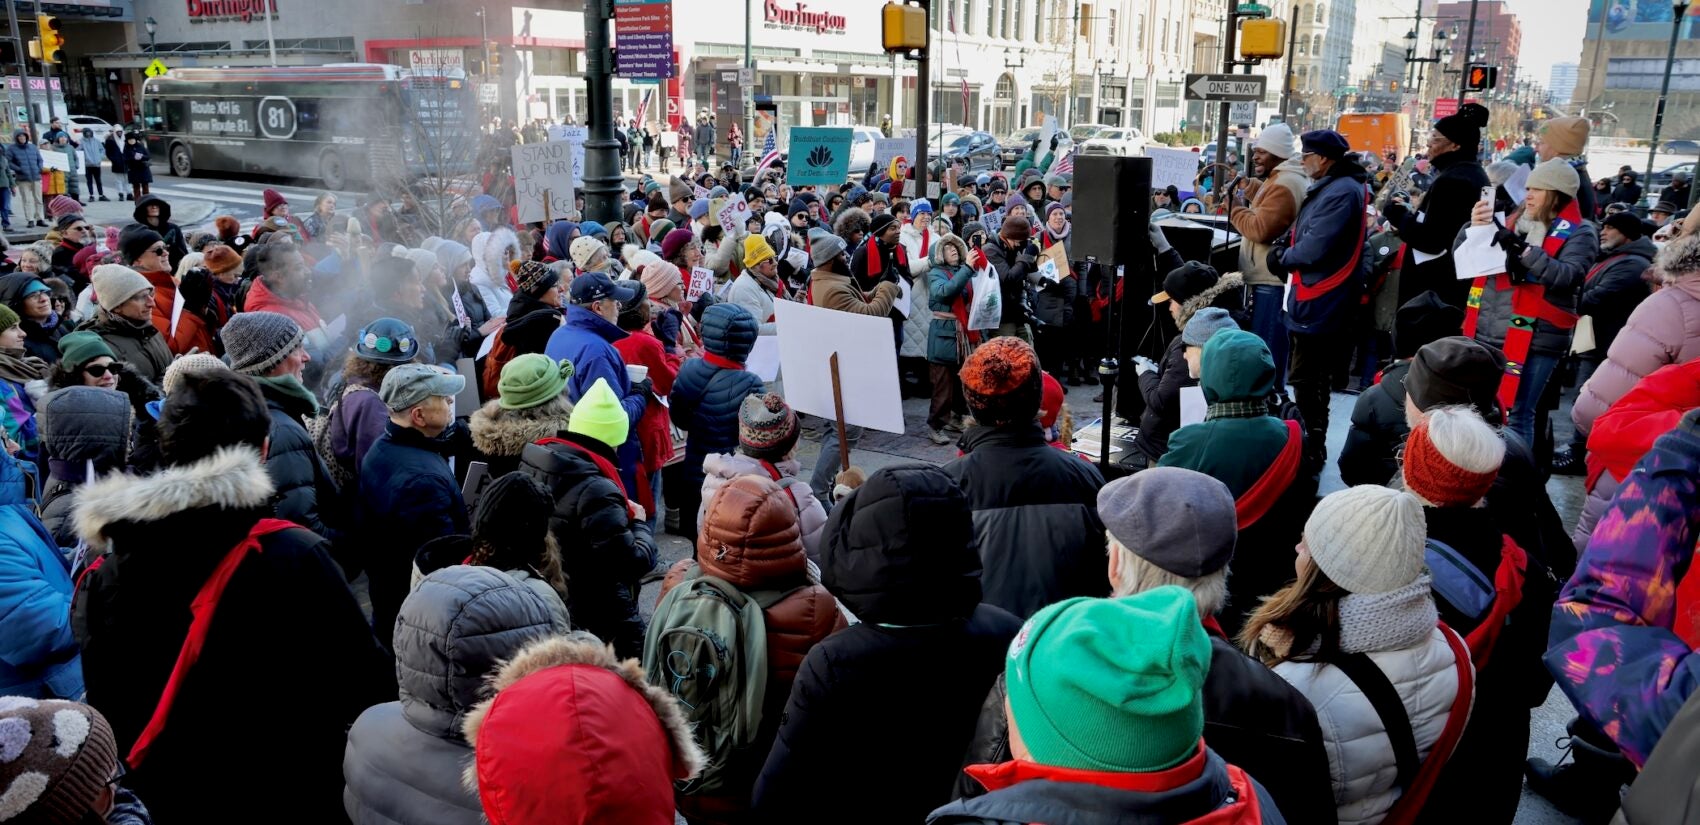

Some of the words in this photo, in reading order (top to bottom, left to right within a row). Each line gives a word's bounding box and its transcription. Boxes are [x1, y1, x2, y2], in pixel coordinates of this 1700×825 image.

[764, 0, 846, 35] Burlington
[1208, 82, 1231, 93] ONE
[1234, 83, 1258, 94] WAY
[190, 101, 217, 114] Route
[216, 102, 231, 115] XH
[231, 102, 241, 115] is
[1236, 103, 1249, 111] NO
[267, 106, 286, 128] 81
[1231, 112, 1253, 121] TURNS
[191, 120, 210, 131] now
[210, 118, 236, 132] Route
[237, 119, 252, 132] 81.
[793, 135, 822, 143] Buddhist
[522, 144, 563, 162] STAND
[521, 163, 540, 179] UP
[543, 160, 567, 176] FOR
[719, 202, 736, 219] STOP
[693, 270, 707, 280] STOP
[691, 279, 702, 289] ICE
